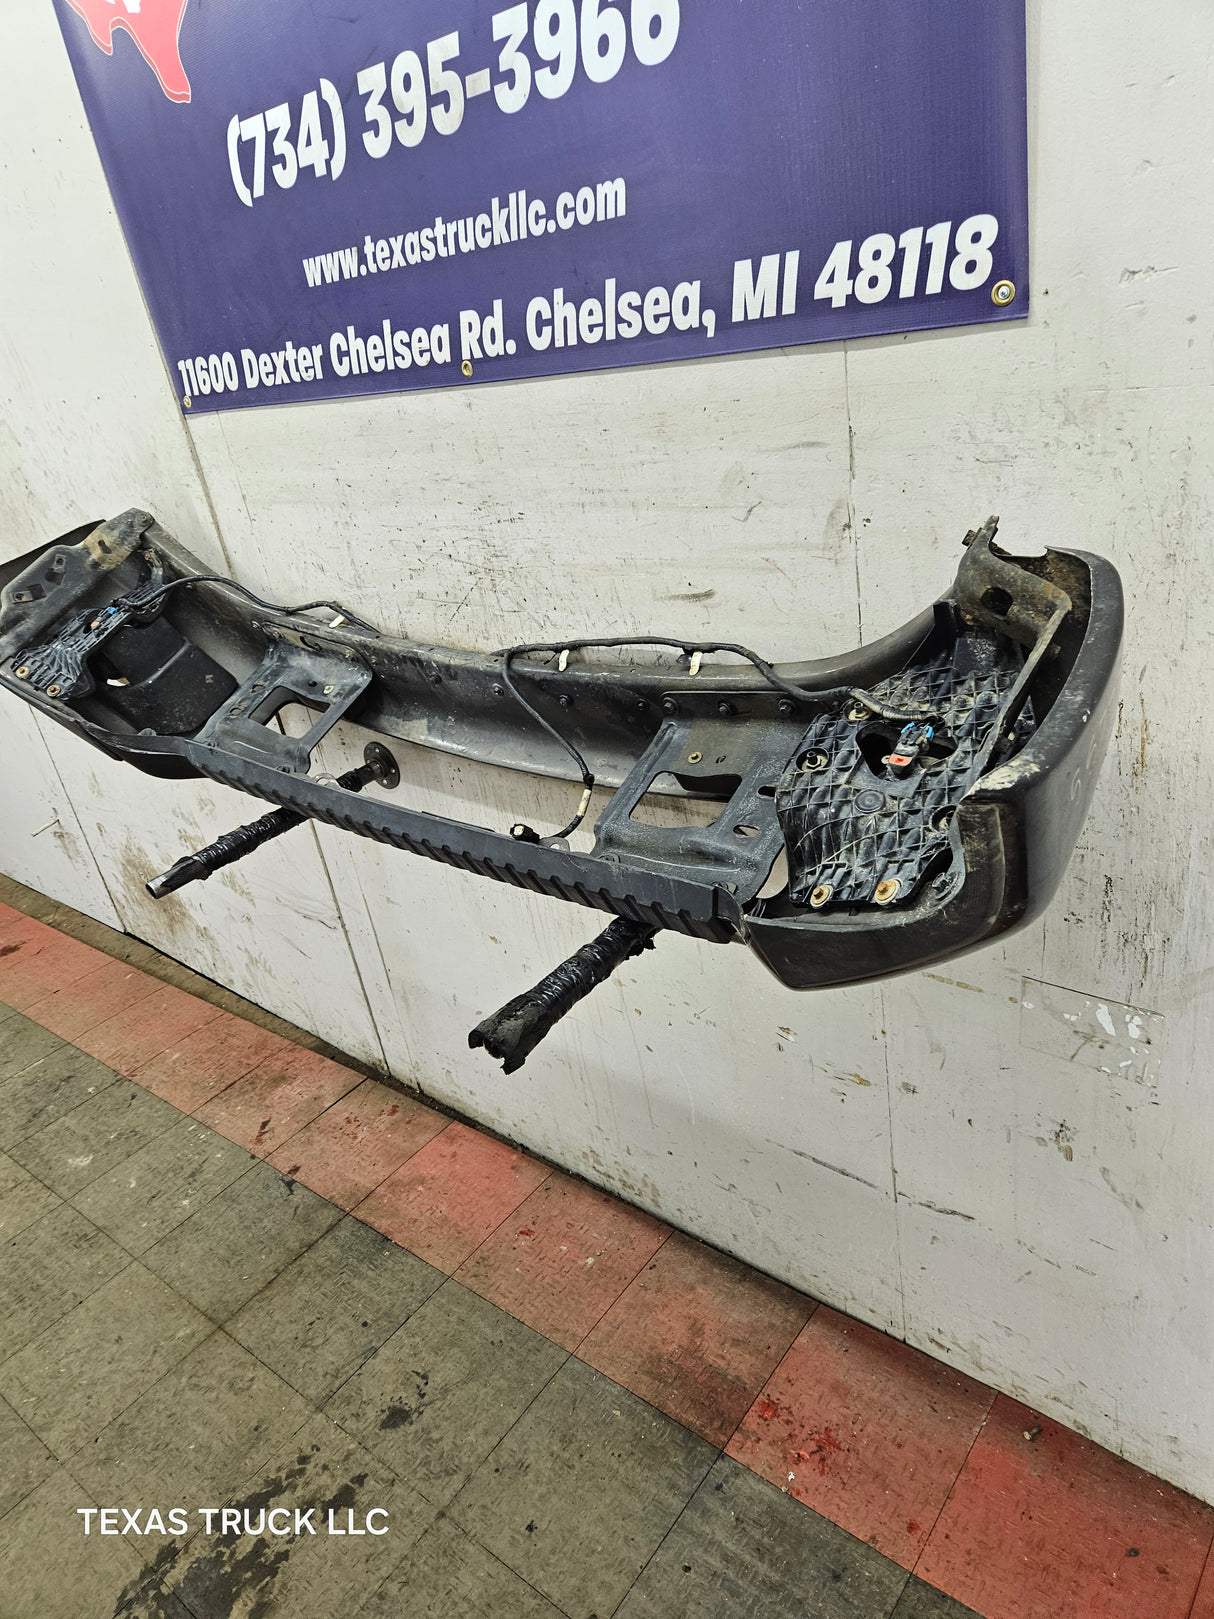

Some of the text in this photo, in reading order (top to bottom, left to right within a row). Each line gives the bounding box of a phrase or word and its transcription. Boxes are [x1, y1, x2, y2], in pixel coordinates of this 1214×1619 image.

[227, 78, 347, 207] (734)
[302, 176, 628, 288] www.texastruckllc.com
[178, 213, 999, 399] 11600 Dexter Chelsea Rd. Chelsea, MI 48118
